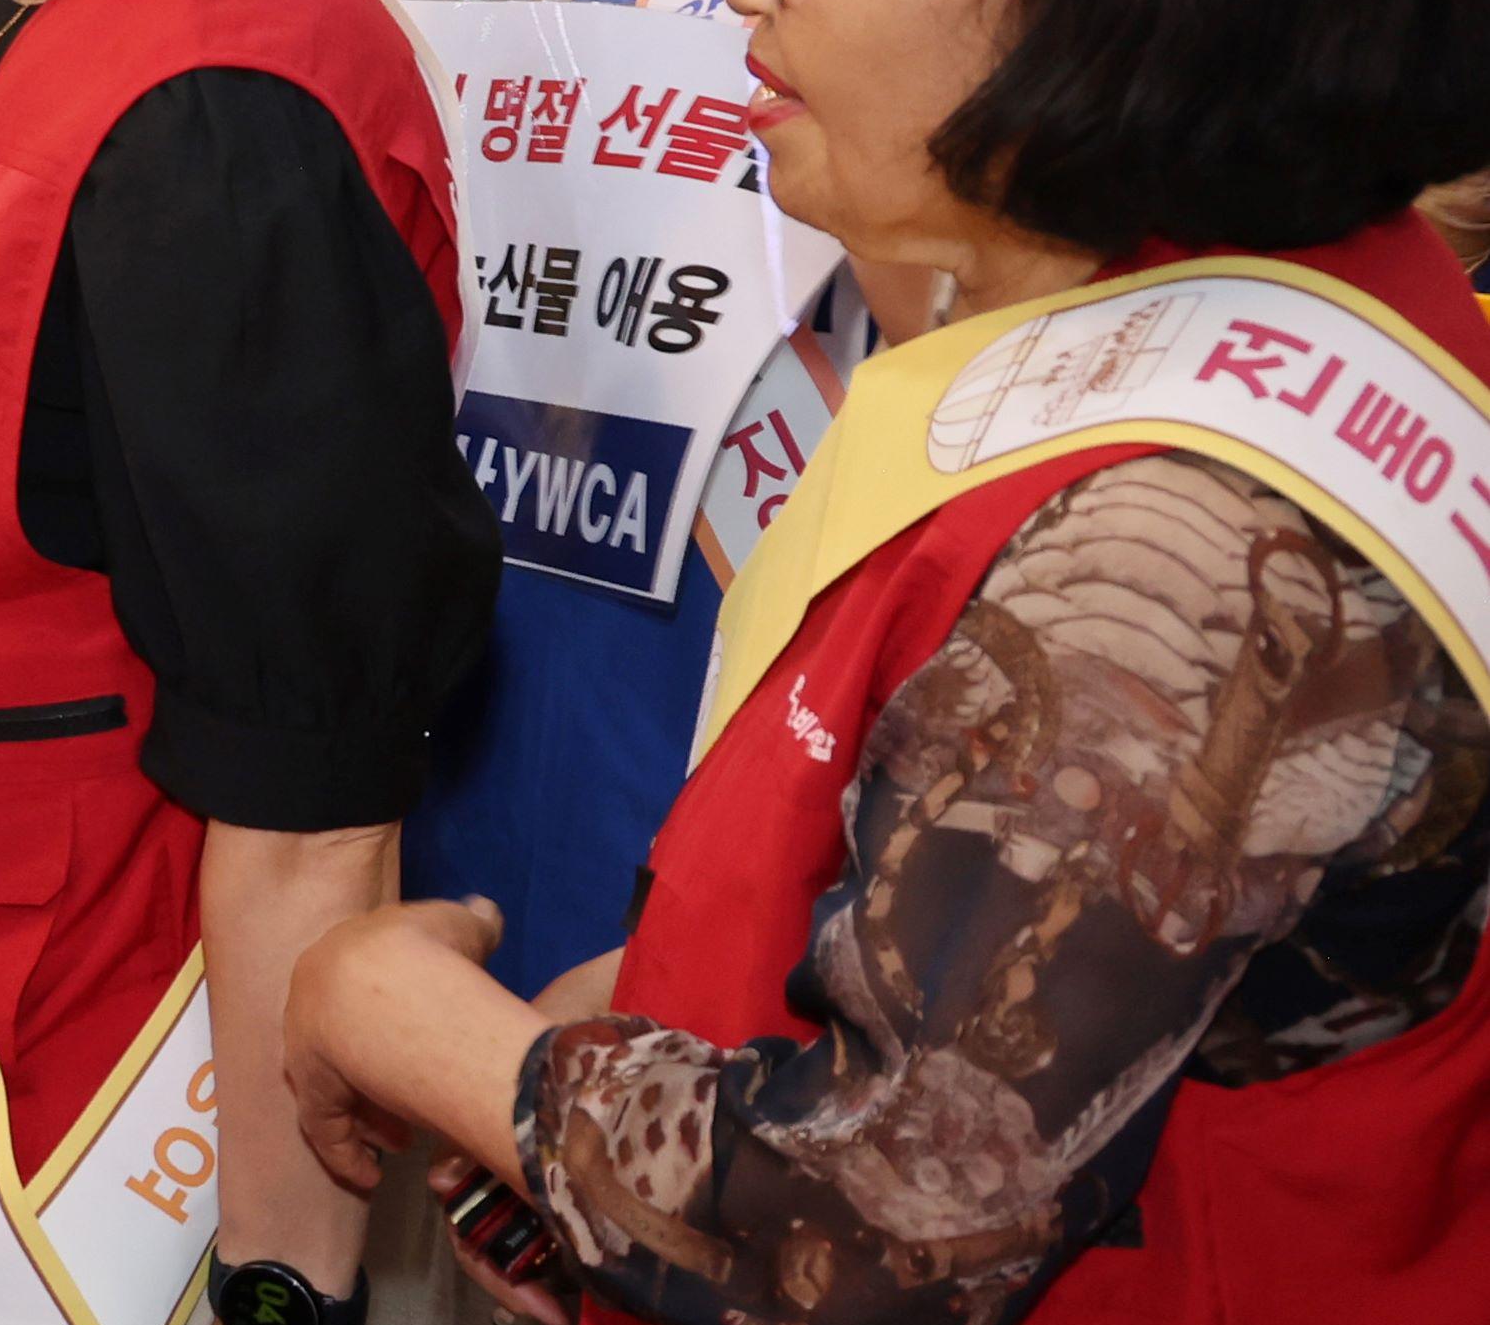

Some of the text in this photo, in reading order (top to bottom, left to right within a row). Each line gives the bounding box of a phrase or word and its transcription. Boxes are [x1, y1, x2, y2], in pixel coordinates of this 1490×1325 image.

[480, 75, 585, 164] 명절
[475, 243, 732, 354] 산물 애용
